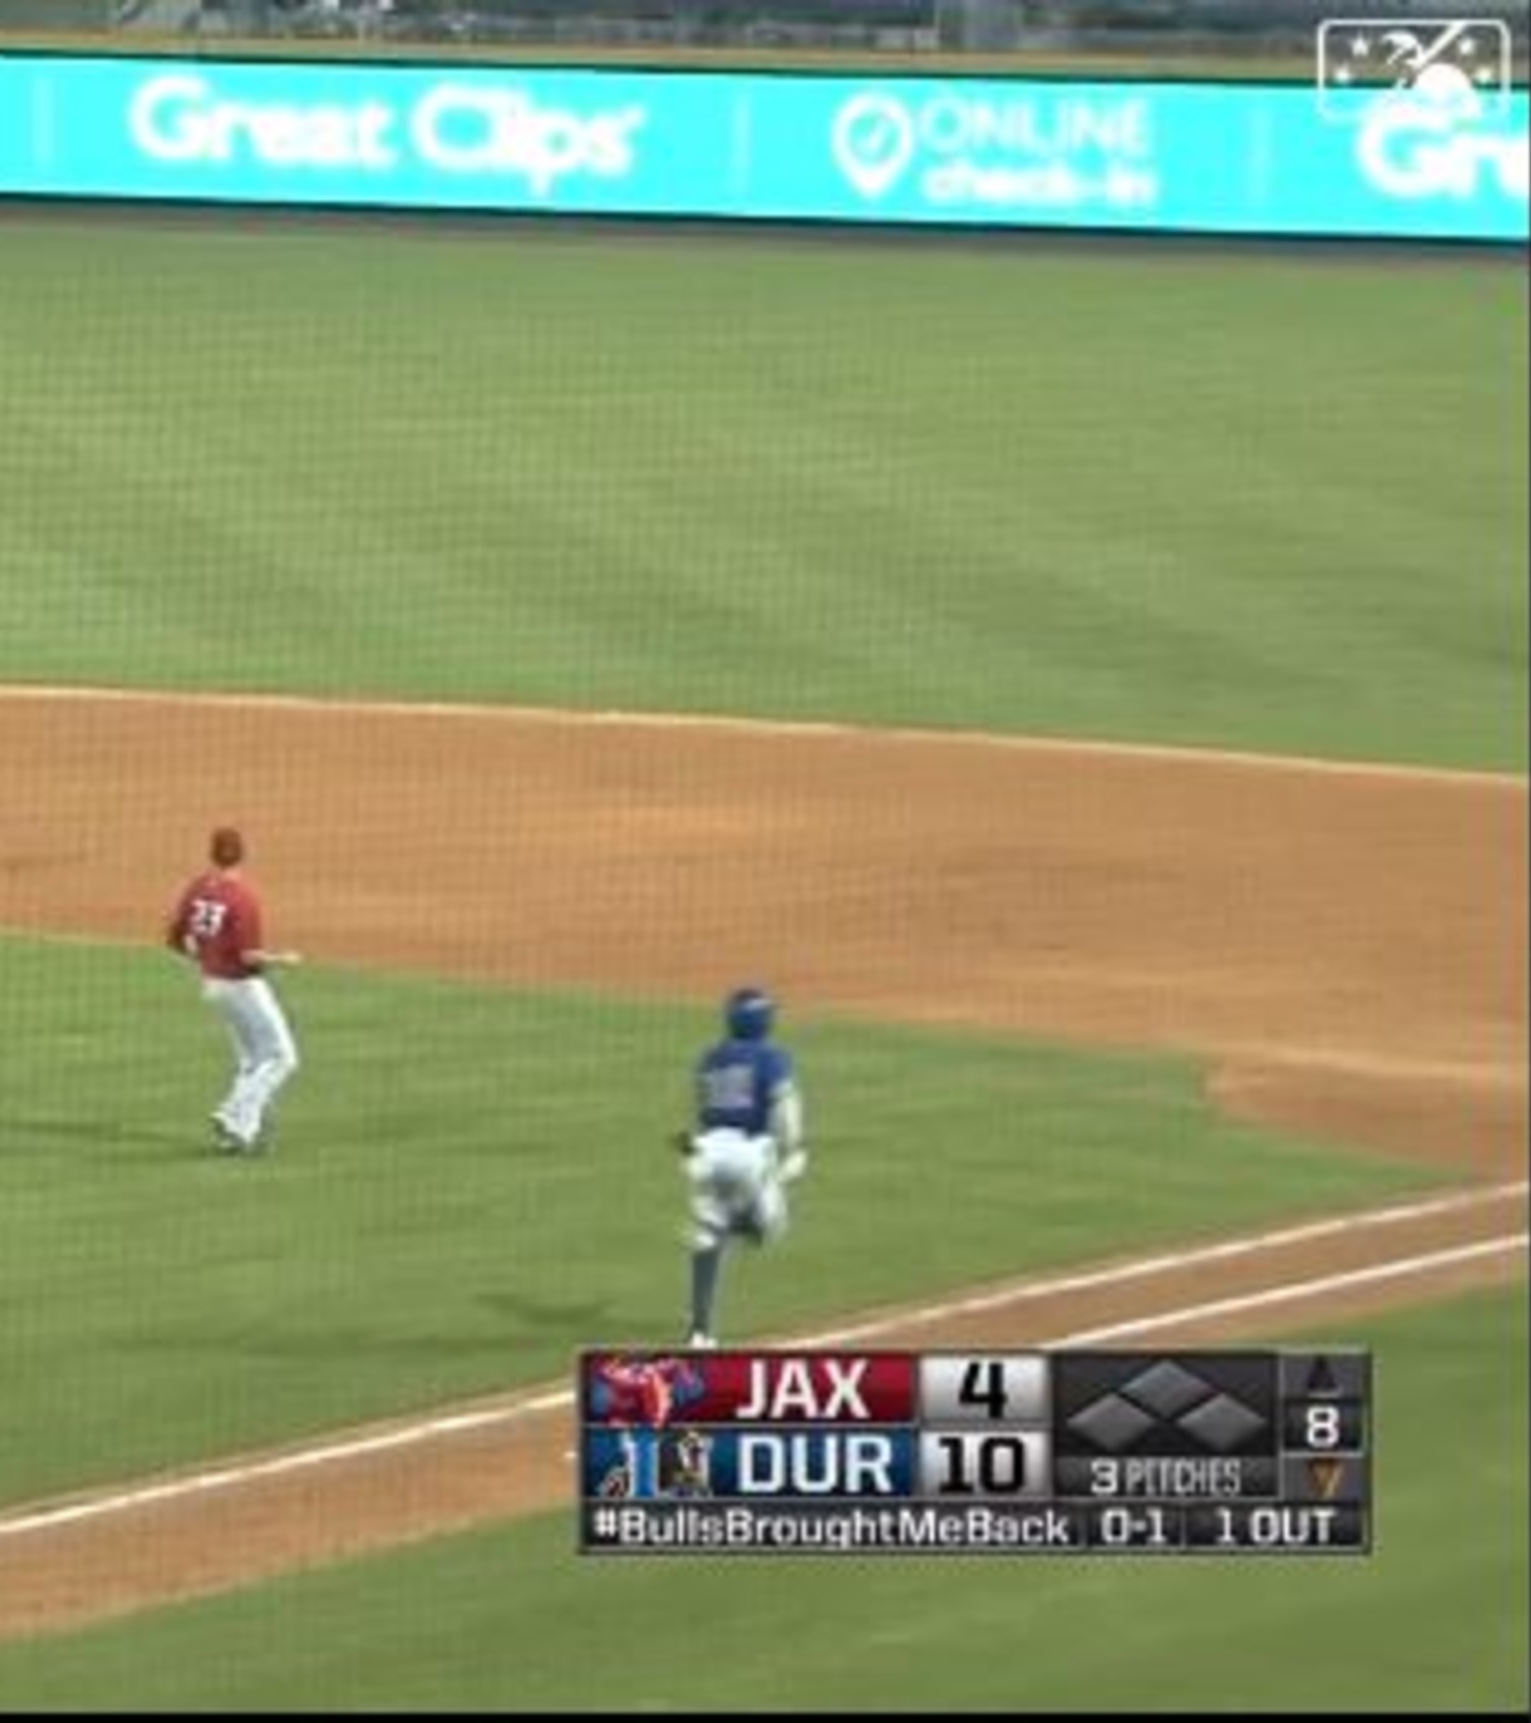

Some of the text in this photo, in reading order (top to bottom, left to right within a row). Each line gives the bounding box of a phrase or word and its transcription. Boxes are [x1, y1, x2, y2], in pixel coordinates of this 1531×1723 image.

[129, 74, 398, 168] Great
[920, 96, 1152, 152] ONLINE
[920, 160, 1158, 204] check-in
